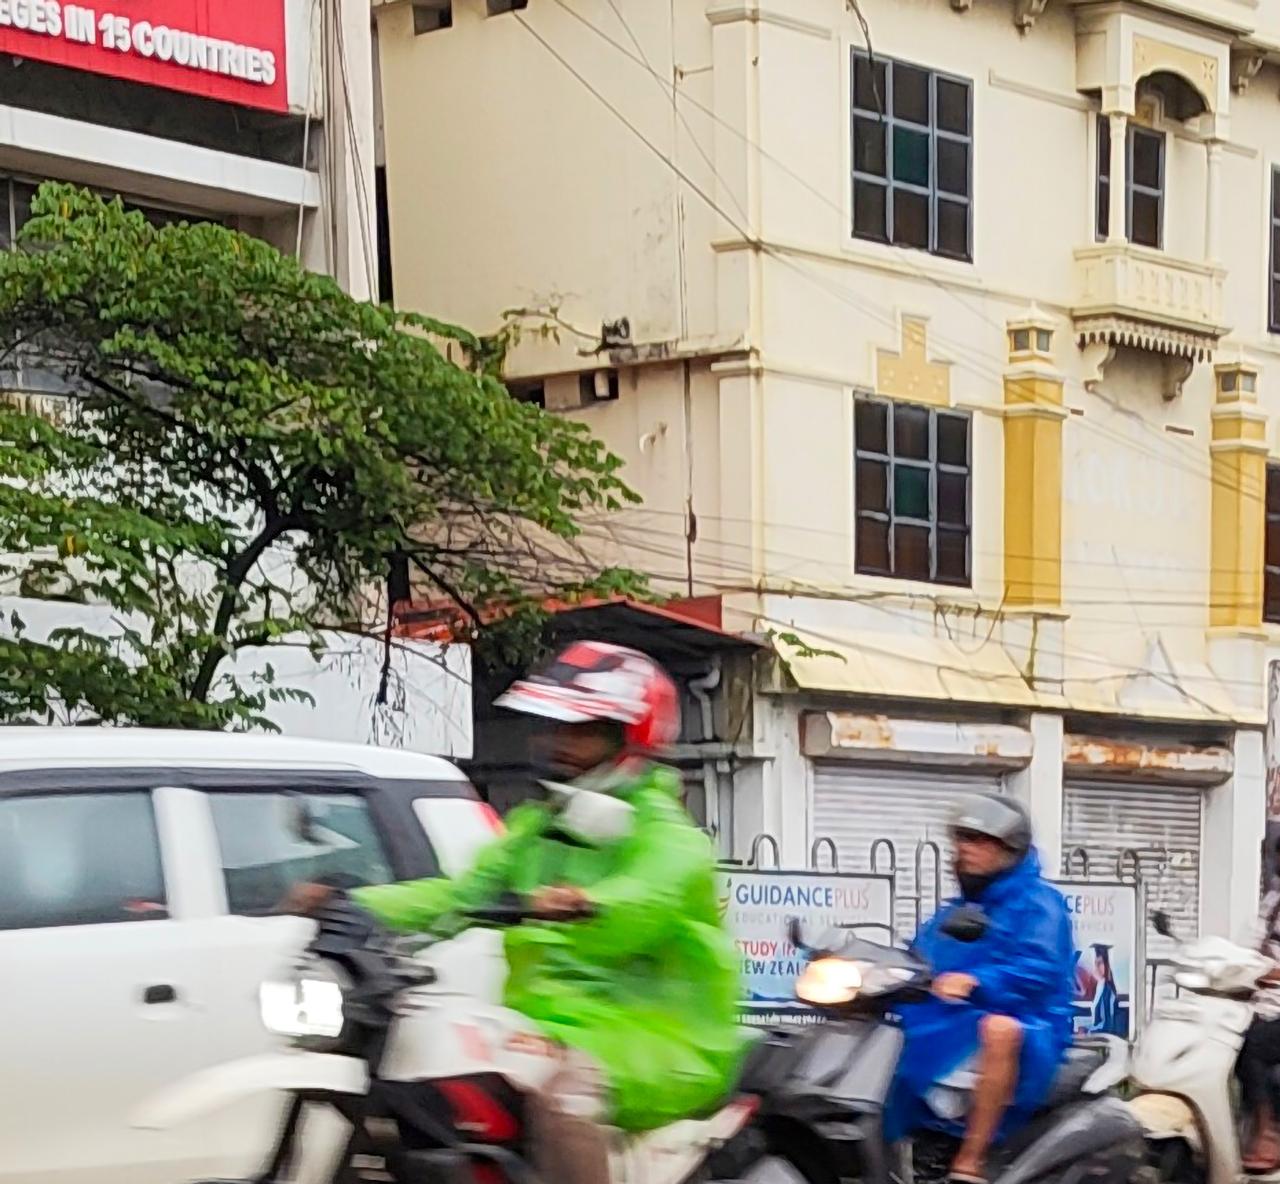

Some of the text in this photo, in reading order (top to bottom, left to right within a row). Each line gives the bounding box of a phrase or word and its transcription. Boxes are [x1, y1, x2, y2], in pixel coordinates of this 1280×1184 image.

[64, 5, 96, 44] IN
[98, 13, 131, 52] 15
[132, 21, 276, 85] COUNTRIES
[735, 883, 870, 910] GUIDANCEPLUS
[741, 959, 766, 975] EW
